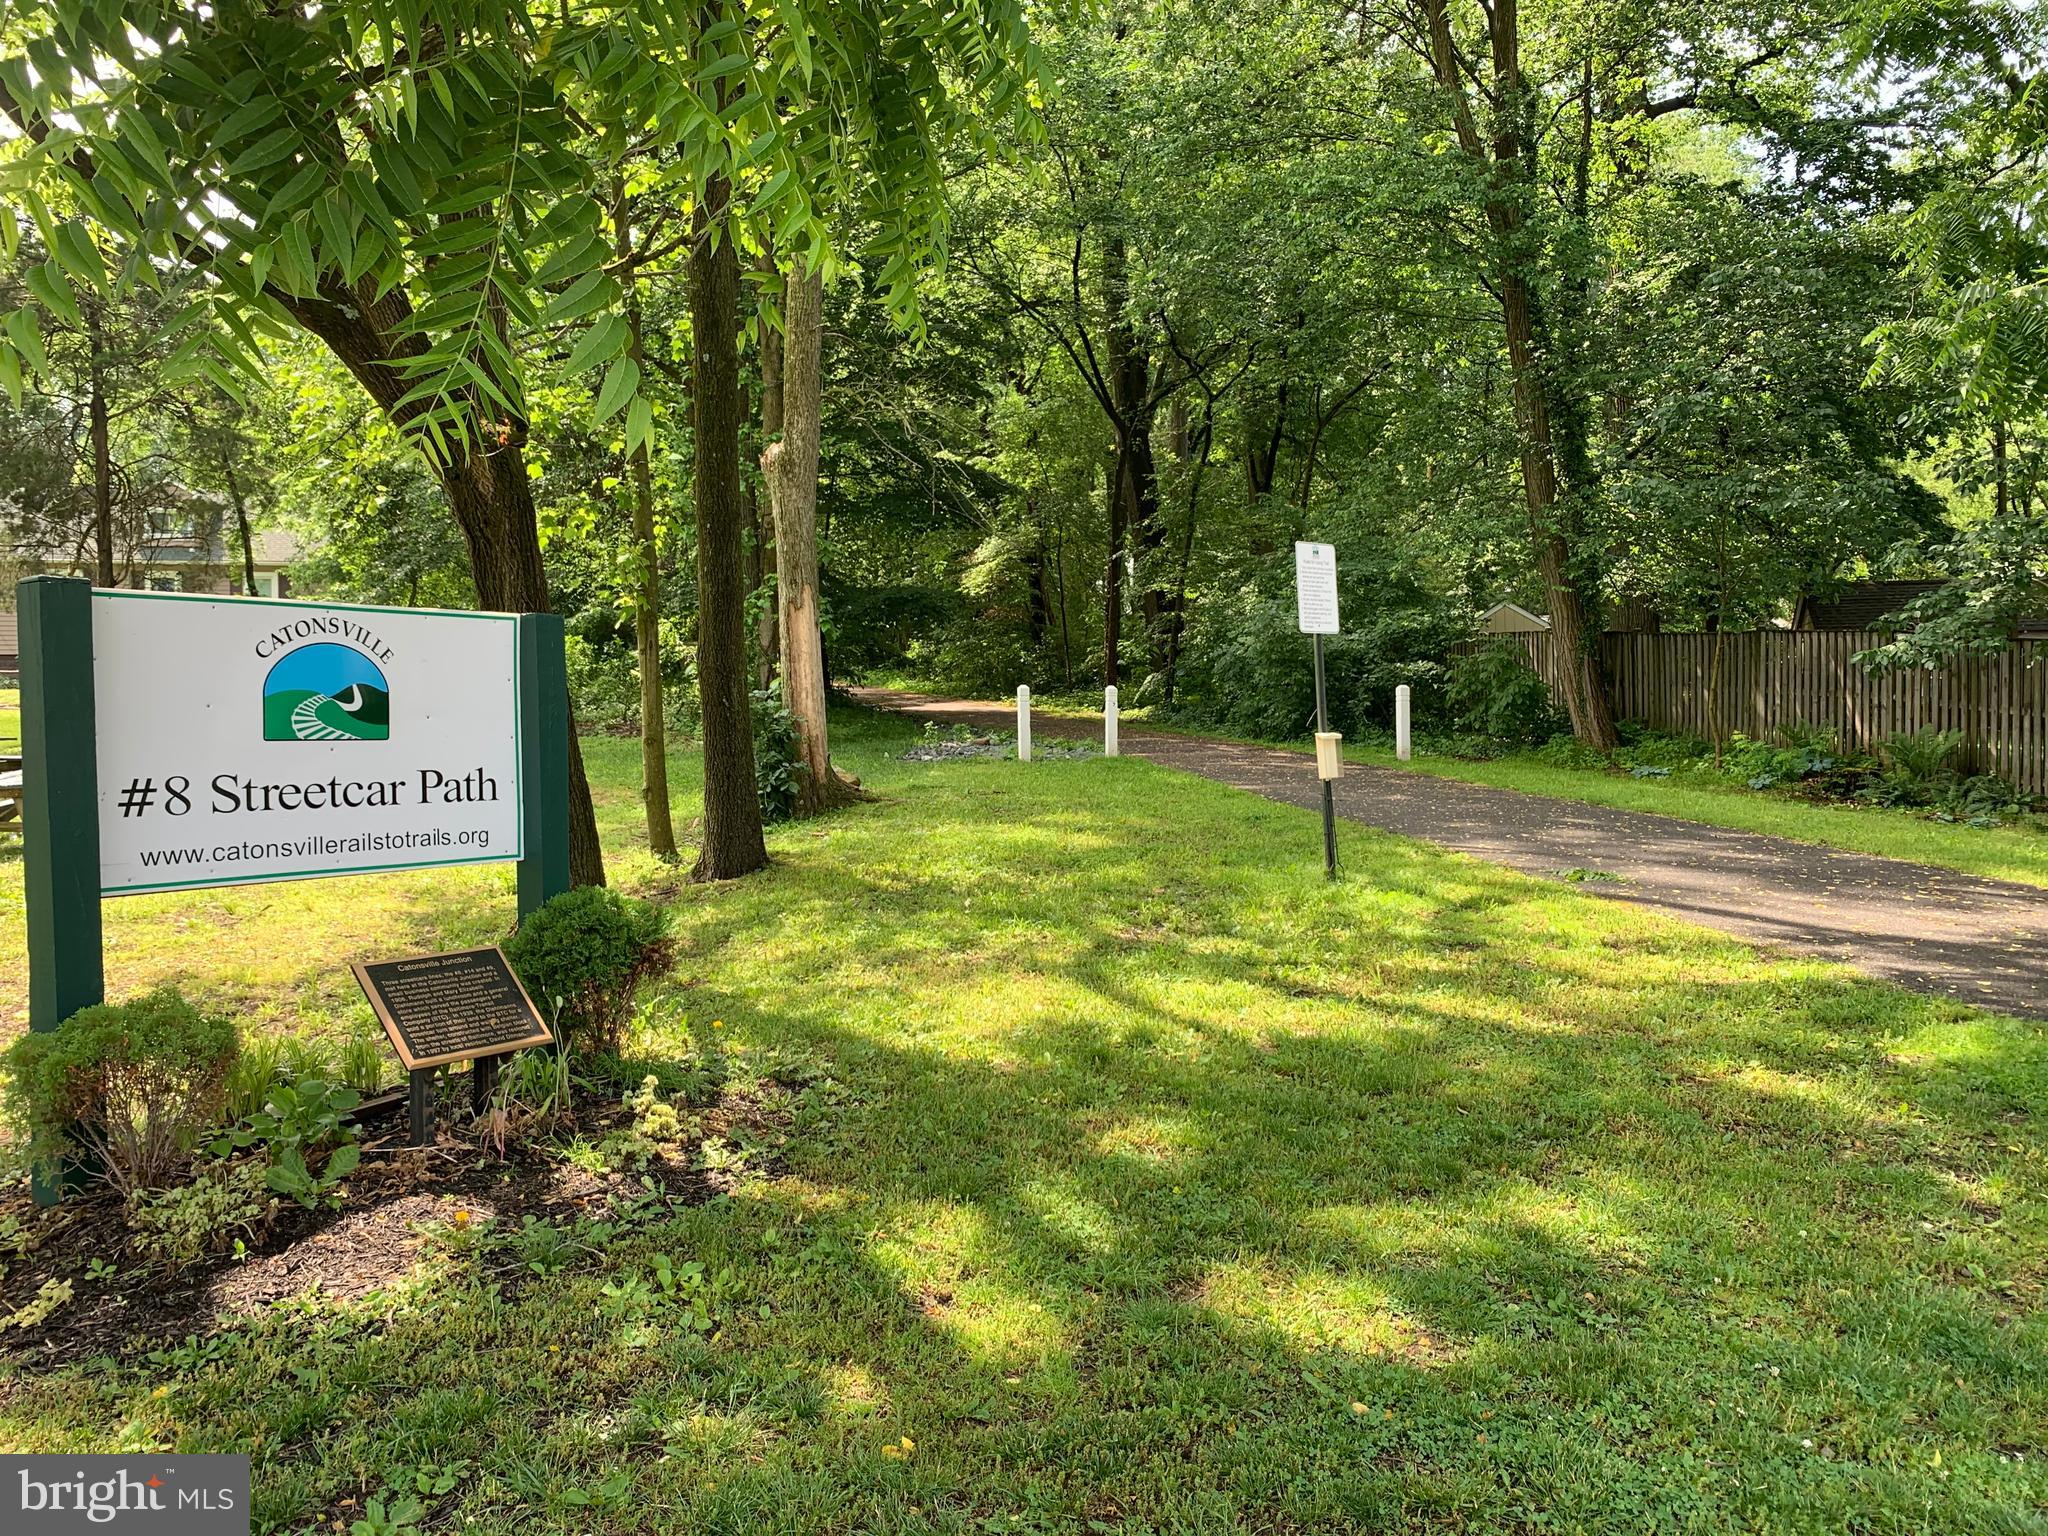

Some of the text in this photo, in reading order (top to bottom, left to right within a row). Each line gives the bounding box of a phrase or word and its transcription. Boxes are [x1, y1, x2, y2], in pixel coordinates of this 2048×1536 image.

[255, 617, 394, 665] CATONSVILLE
[117, 767, 499, 818] #8 Streetcar Path
[140, 827, 490, 867] www.catonsvillerailstotrails.org
[397, 955, 471, 971] Catonsville Junction
